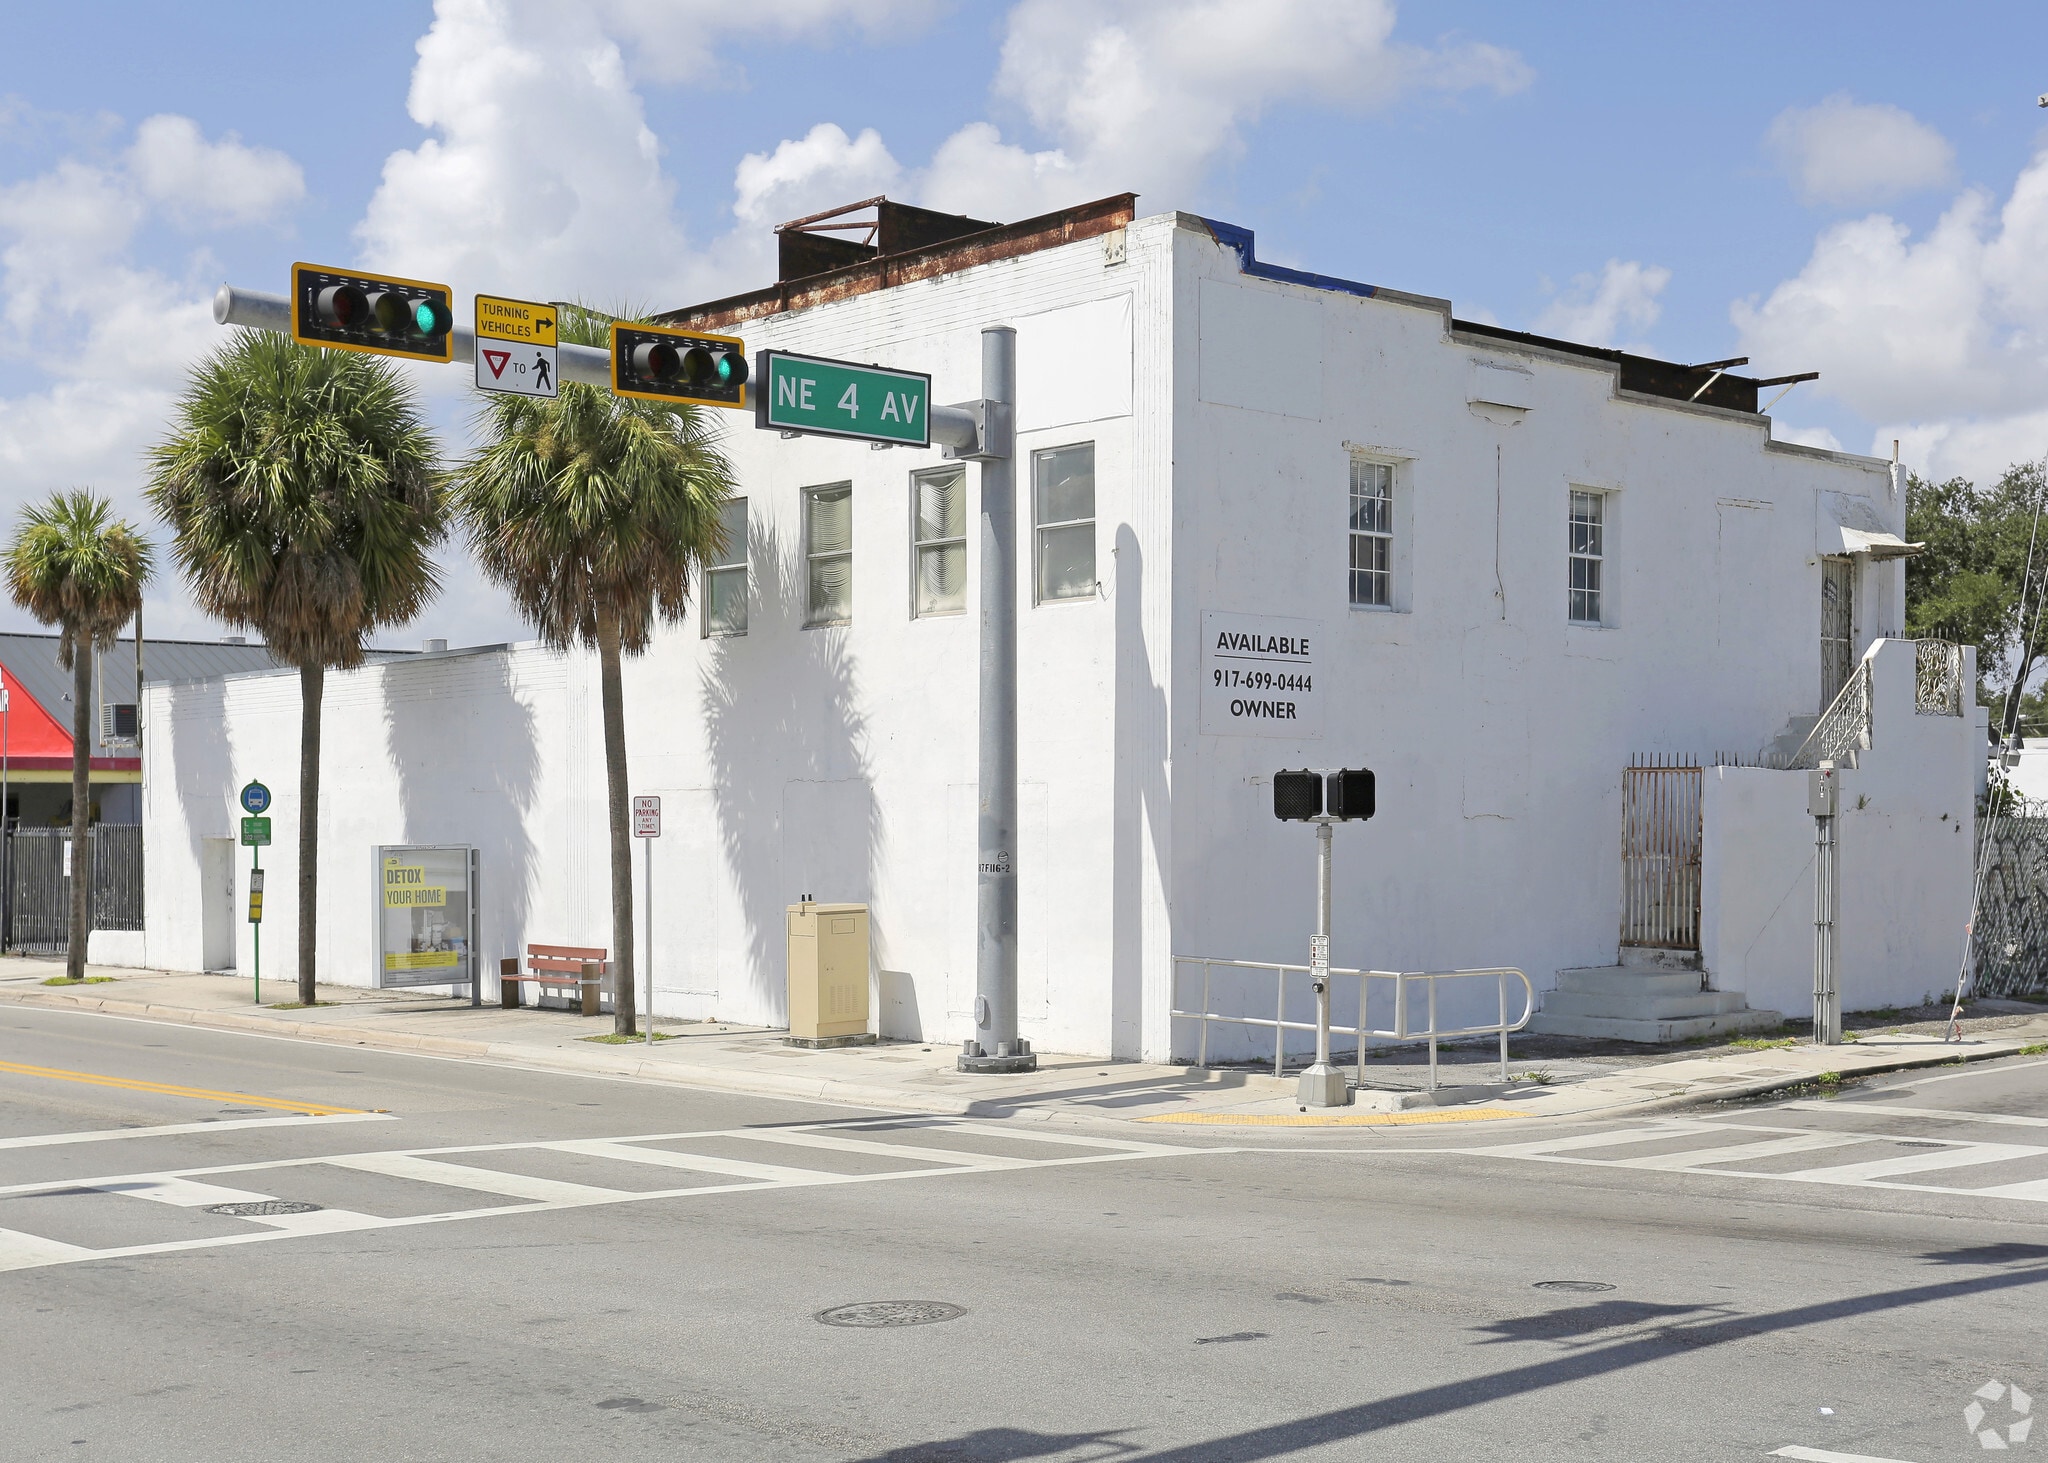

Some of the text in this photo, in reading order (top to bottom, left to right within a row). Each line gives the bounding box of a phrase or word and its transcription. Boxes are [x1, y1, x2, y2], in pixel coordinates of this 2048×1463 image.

[482, 303, 529, 320] TURNING
[481, 319, 531, 337] VEHICLES
[513, 362, 526, 374] TO
[778, 374, 919, 424] NE 4 AV
[1216, 631, 1309, 655] AVAILABLE
[1213, 669, 1312, 692] 917-699-0444
[1230, 699, 1297, 719] OWNER
[642, 800, 652, 808] NO
[635, 809, 658, 817] PARKING
[387, 869, 421, 884] DETOX
[387, 889, 441, 904] YOUR HOME
